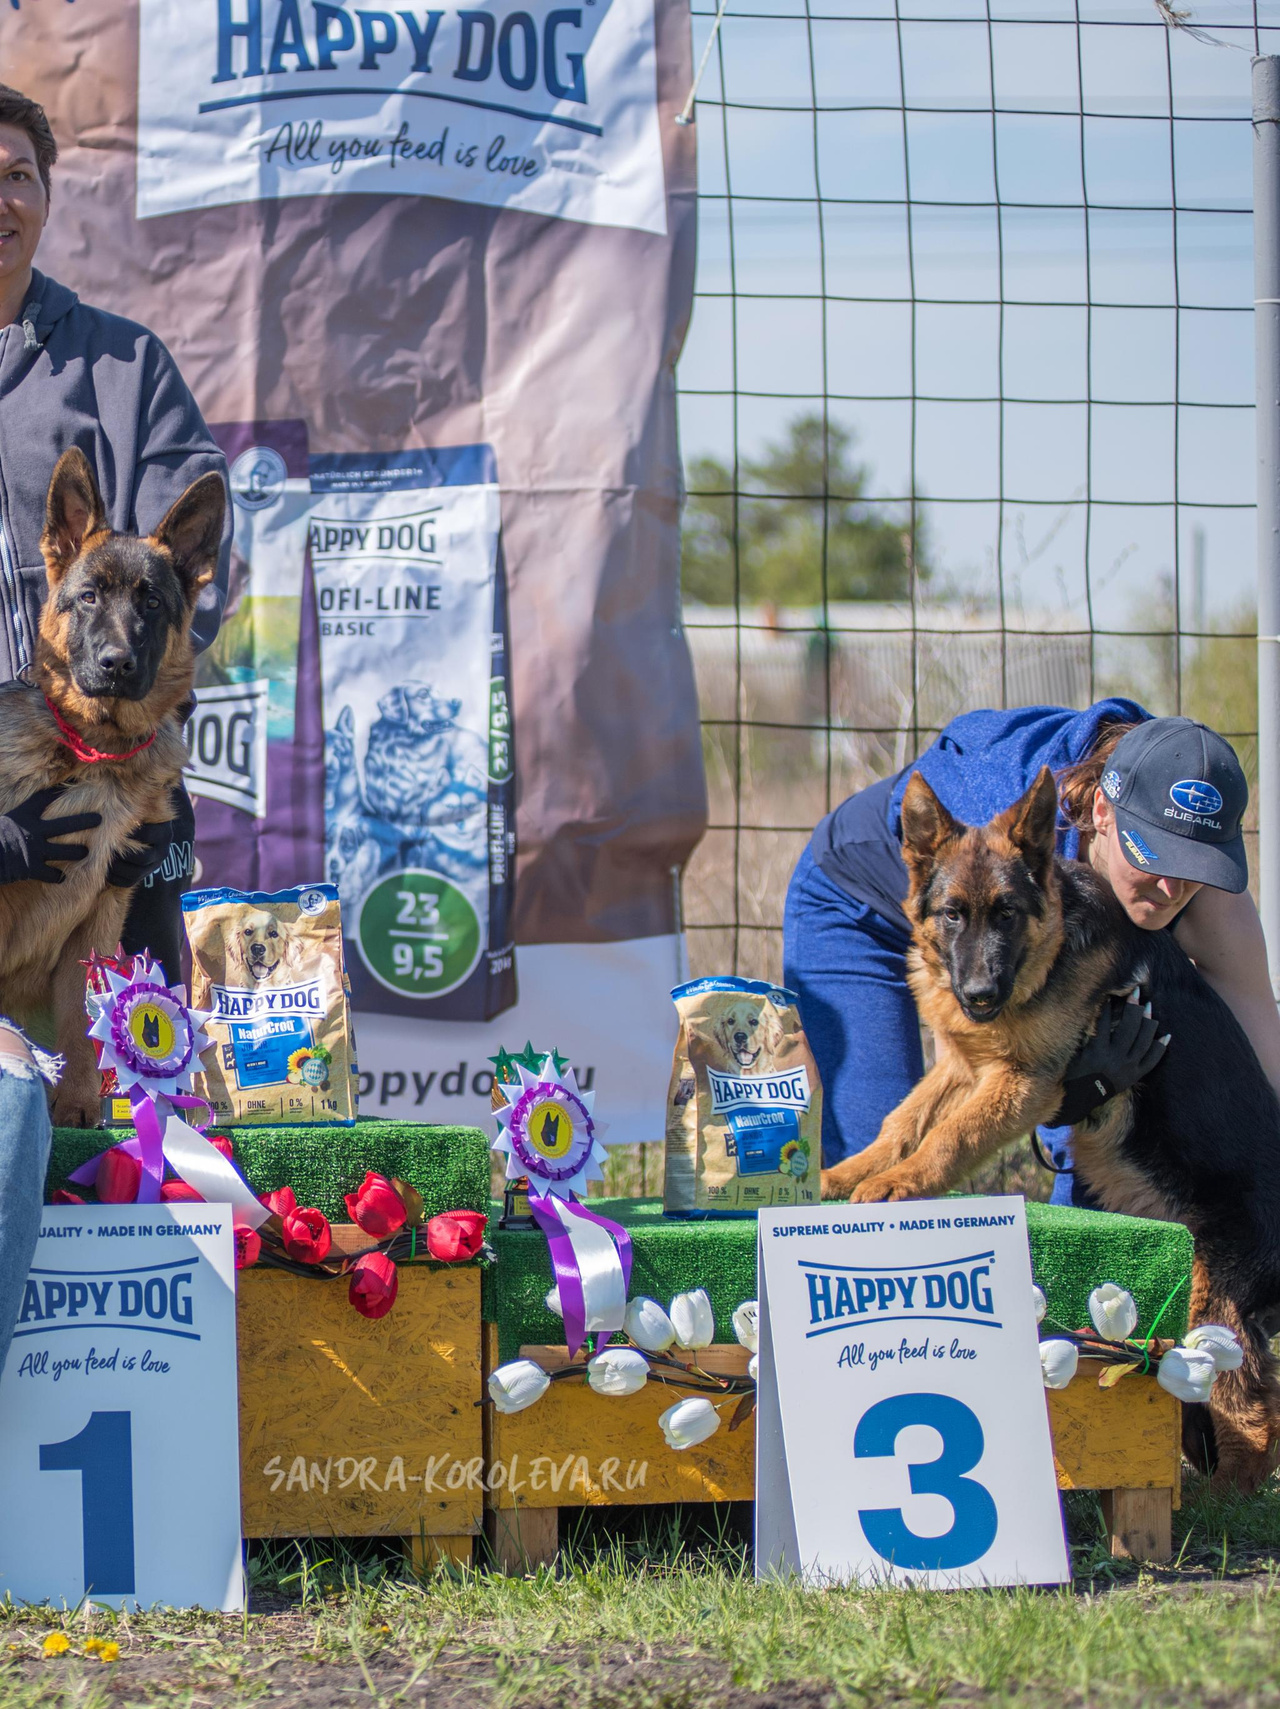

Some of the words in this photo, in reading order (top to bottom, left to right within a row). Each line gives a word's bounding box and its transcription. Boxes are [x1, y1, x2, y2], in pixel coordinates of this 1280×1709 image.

[211, 0, 444, 83] HAPPY
[453, 8, 588, 104] DOG
[265, 122, 320, 163] All
[328, 137, 384, 176] you
[388, 127, 450, 168] feed
[455, 141, 479, 168] is
[485, 135, 540, 178] love
[378, 517, 437, 554] DOG
[321, 621, 377, 637] BASIC
[1164, 807, 1220, 829] SUBARU
[490, 803, 506, 886] PROFI-LINE
[394, 891, 441, 927] 23
[392, 945, 445, 981] 9,5
[216, 991, 278, 1016] HAPPY
[281, 987, 321, 1009] DOG
[238, 1020, 296, 1040] NaturCroq
[247, 1100, 266, 1109] OHNE
[327, 1099, 338, 1110] kg
[711, 1078, 764, 1103] HAPPY
[766, 1077, 806, 1100] DOG
[735, 1111, 785, 1128] NaturCroq
[743, 1187, 760, 1195] OHNE
[98, 1226, 136, 1237] MADE
[139, 1225, 153, 1236] IN
[155, 1224, 223, 1236] GERMANY
[772, 1224, 830, 1238] SUPREME
[832, 1221, 885, 1235] QUALITY
[899, 1219, 935, 1232] MADE
[937, 1218, 951, 1229] IN
[953, 1214, 1016, 1228] GERMANY
[17, 1280, 113, 1324] APPY
[119, 1272, 193, 1325] DOG
[804, 1272, 919, 1325] HAPPY
[922, 1265, 994, 1315] DOG
[17, 1351, 49, 1378] All
[52, 1357, 84, 1382] you
[85, 1347, 119, 1374] feed
[122, 1354, 137, 1371] is
[141, 1349, 171, 1374] love
[837, 1343, 866, 1369] All
[868, 1347, 897, 1371] you
[898, 1338, 928, 1364] feed
[931, 1344, 946, 1359] is
[949, 1338, 977, 1361] love
[853, 1392, 999, 1571] 3
[39, 1411, 136, 1595] 1
